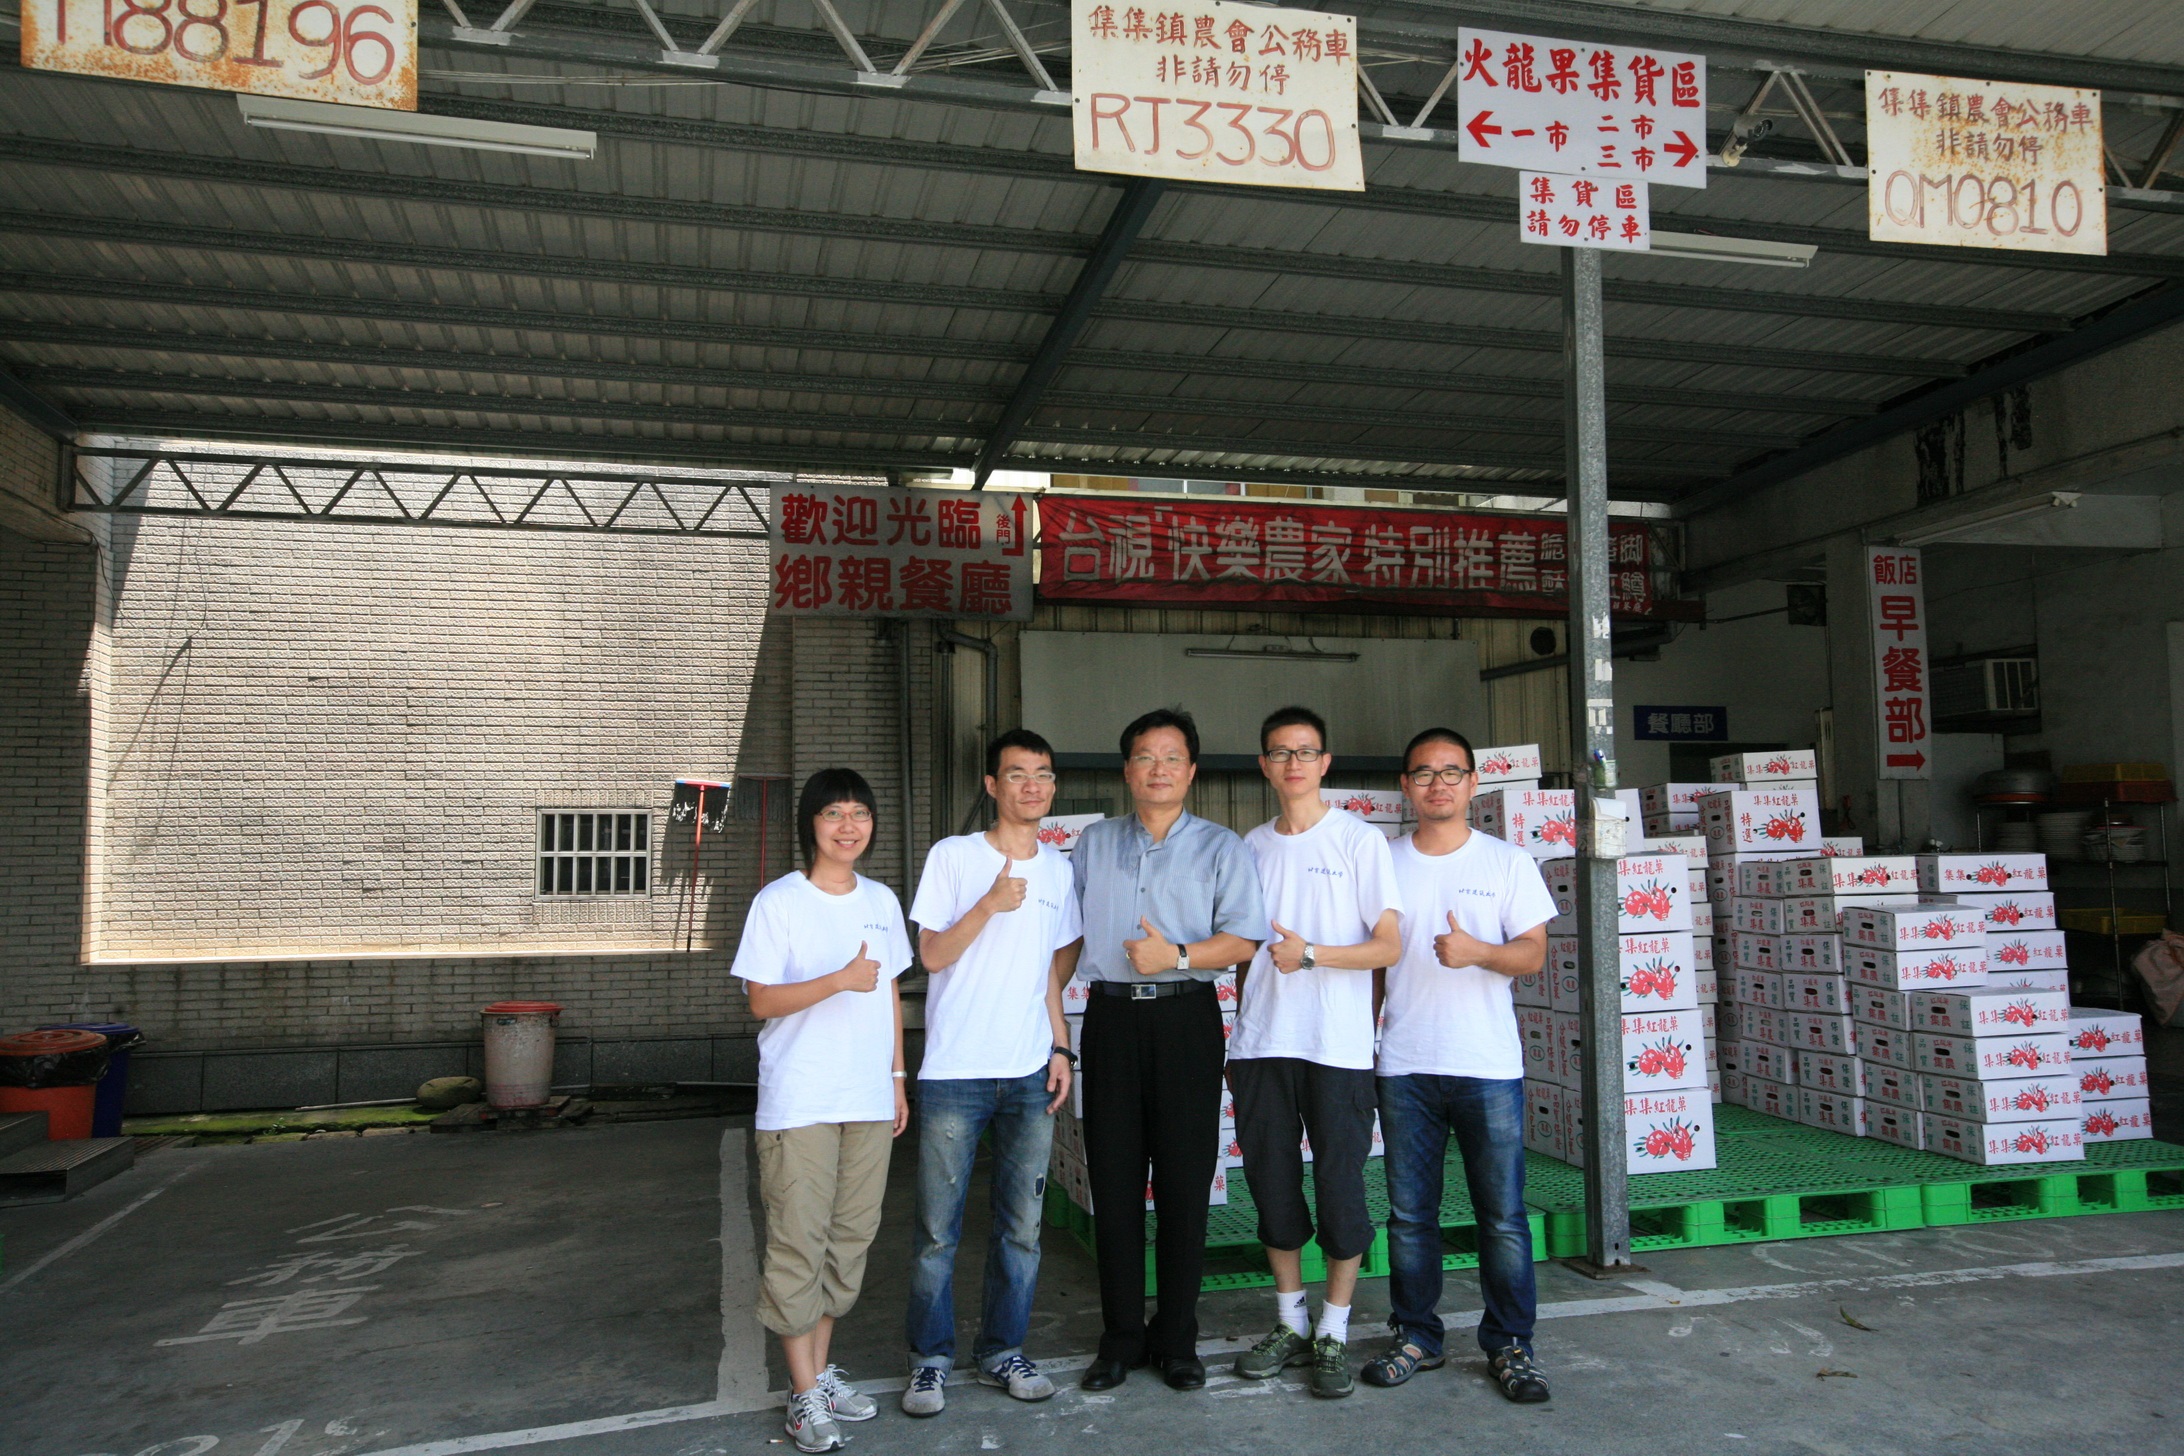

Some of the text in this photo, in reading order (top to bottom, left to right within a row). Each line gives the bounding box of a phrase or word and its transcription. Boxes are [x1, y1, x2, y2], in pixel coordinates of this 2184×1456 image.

[1089, 5, 1351, 66] 集集鎮農會公務車
[1156, 55, 1290, 95] 非請勿停
[1463, 38, 1700, 107] 火龍果集貨區
[1597, 114, 1655, 140] 二市
[1878, 87, 2094, 133] 集集鎮農會公務車
[1090, 93, 1336, 171] RJ3330
[1511, 120, 1569, 152] 一市
[1936, 128, 2043, 165] 非請勿停
[1597, 144, 1656, 172] 三市
[1530, 176, 1637, 209] 集貨區
[1885, 170, 2083, 237] QM0810
[1526, 208, 1641, 243] 請勿停車
[781, 493, 981, 549] 歡迎光臨
[995, 514, 1011, 545] 後門
[774, 554, 1012, 614] 鄉親餐廳
[1873, 554, 1917, 585] 飯店
[1879, 595, 1926, 744] 早餐部
[1647, 712, 1714, 734] 餐廳部
[1618, 937, 1670, 954] 集紅龍菓
